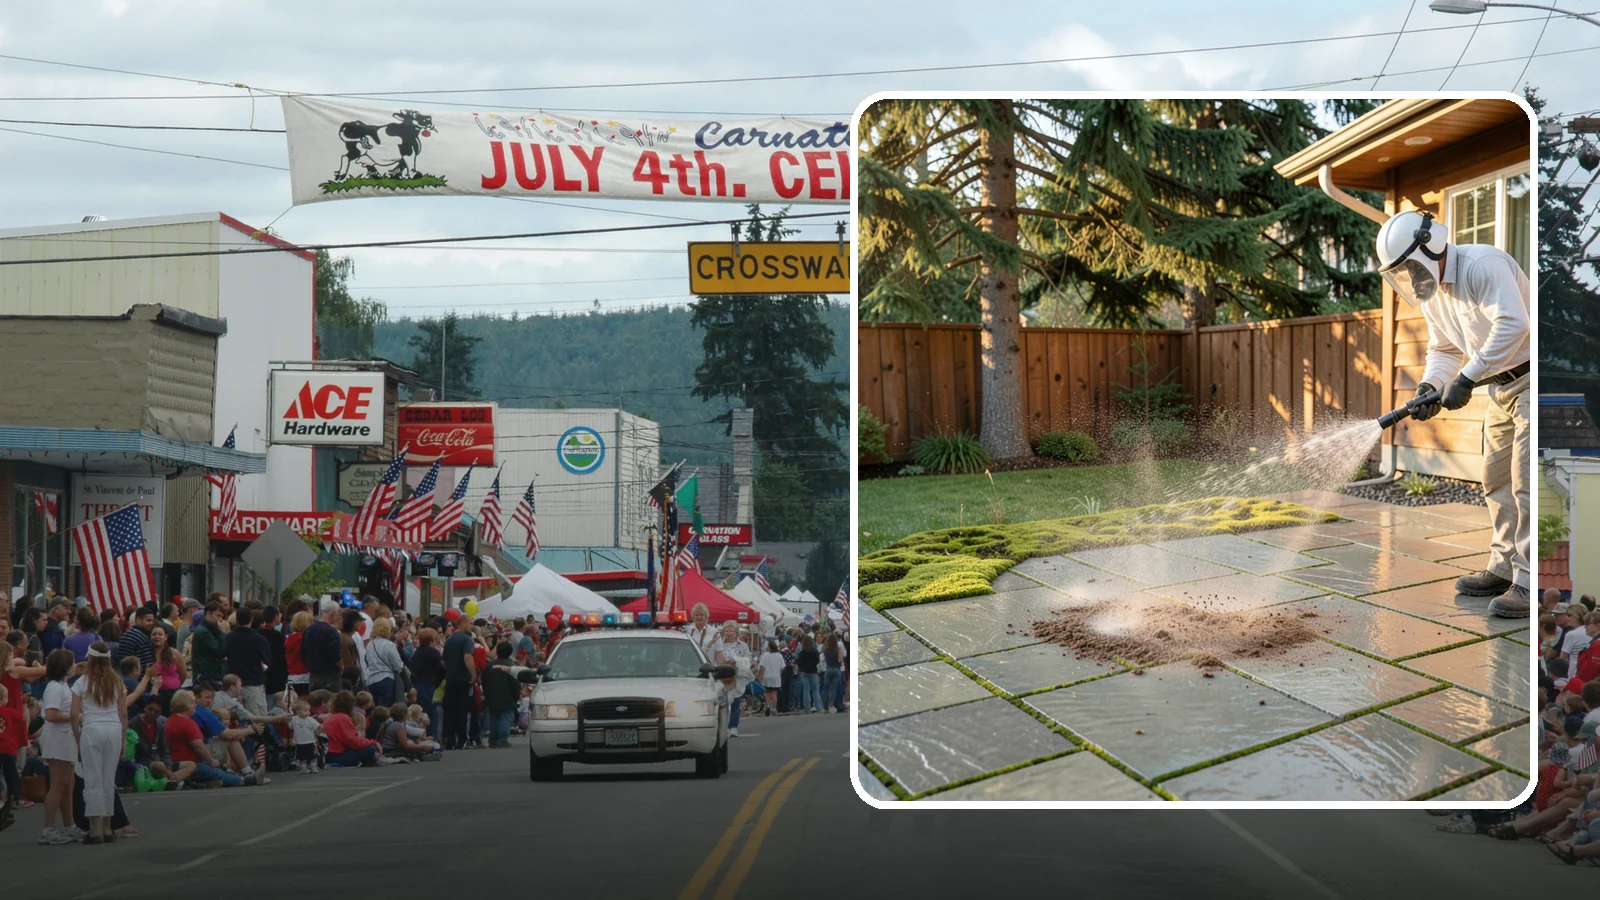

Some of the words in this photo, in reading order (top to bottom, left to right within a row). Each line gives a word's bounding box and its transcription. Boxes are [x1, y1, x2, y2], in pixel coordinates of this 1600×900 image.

[481, 141, 605, 193] JULY
[632, 150, 746, 198] 4th.
[697, 254, 850, 280] CROSSWA
[282, 379, 374, 420] ACE
[406, 409, 453, 422] CEDAR
[461, 409, 485, 422] LOG
[283, 421, 371, 437] Hardware
[416, 428, 477, 447] Coca-Cola
[353, 467, 387, 480] Simpl
[83, 485, 94, 494] St.
[95, 485, 125, 495] Vincent
[126, 486, 136, 495] de
[137, 485, 155, 495] Paul
[688, 526, 741, 535] CRNATION
[699, 535, 730, 543] GLASS
